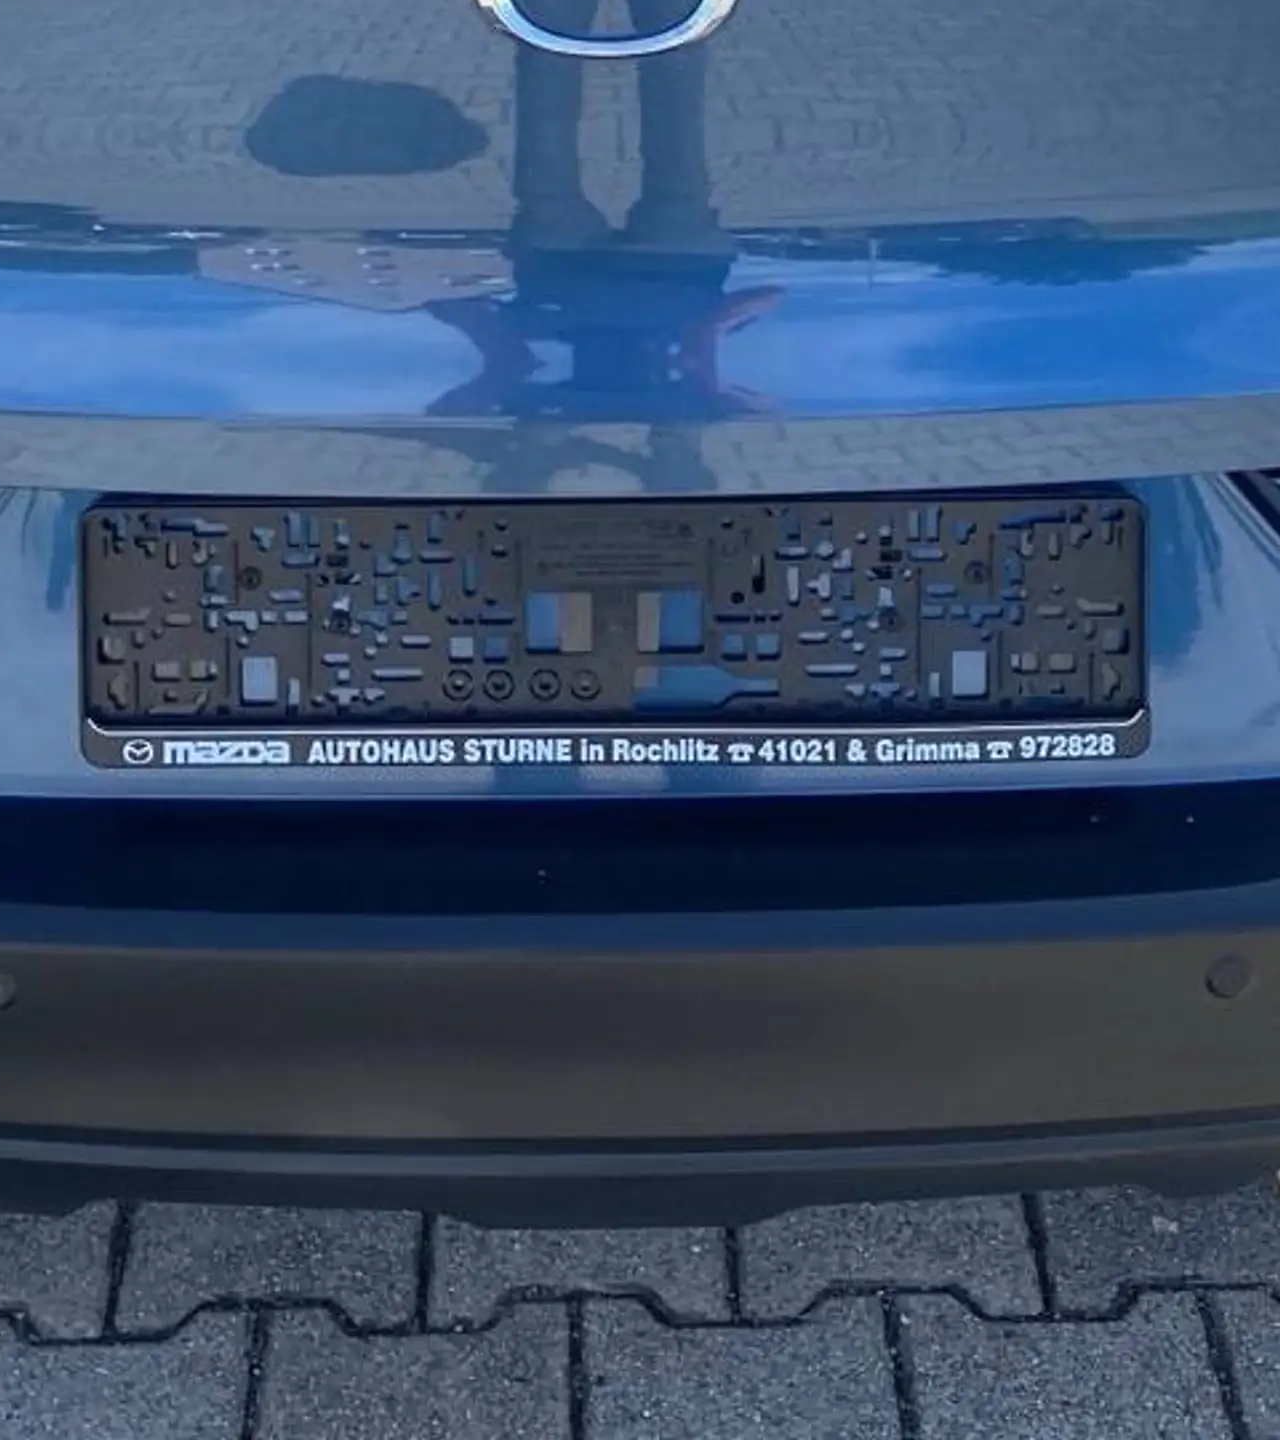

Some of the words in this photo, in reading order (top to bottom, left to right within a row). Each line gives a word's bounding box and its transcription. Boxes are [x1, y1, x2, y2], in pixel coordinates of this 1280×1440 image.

[307, 739, 456, 764] AUTOHAUS
[463, 738, 572, 763] STURNE
[580, 738, 605, 762] in
[612, 738, 720, 762] Rochlitz
[757, 739, 837, 762] 41021
[846, 738, 867, 762] &
[875, 738, 981, 761] Grimma
[1018, 733, 1116, 760] 972828
